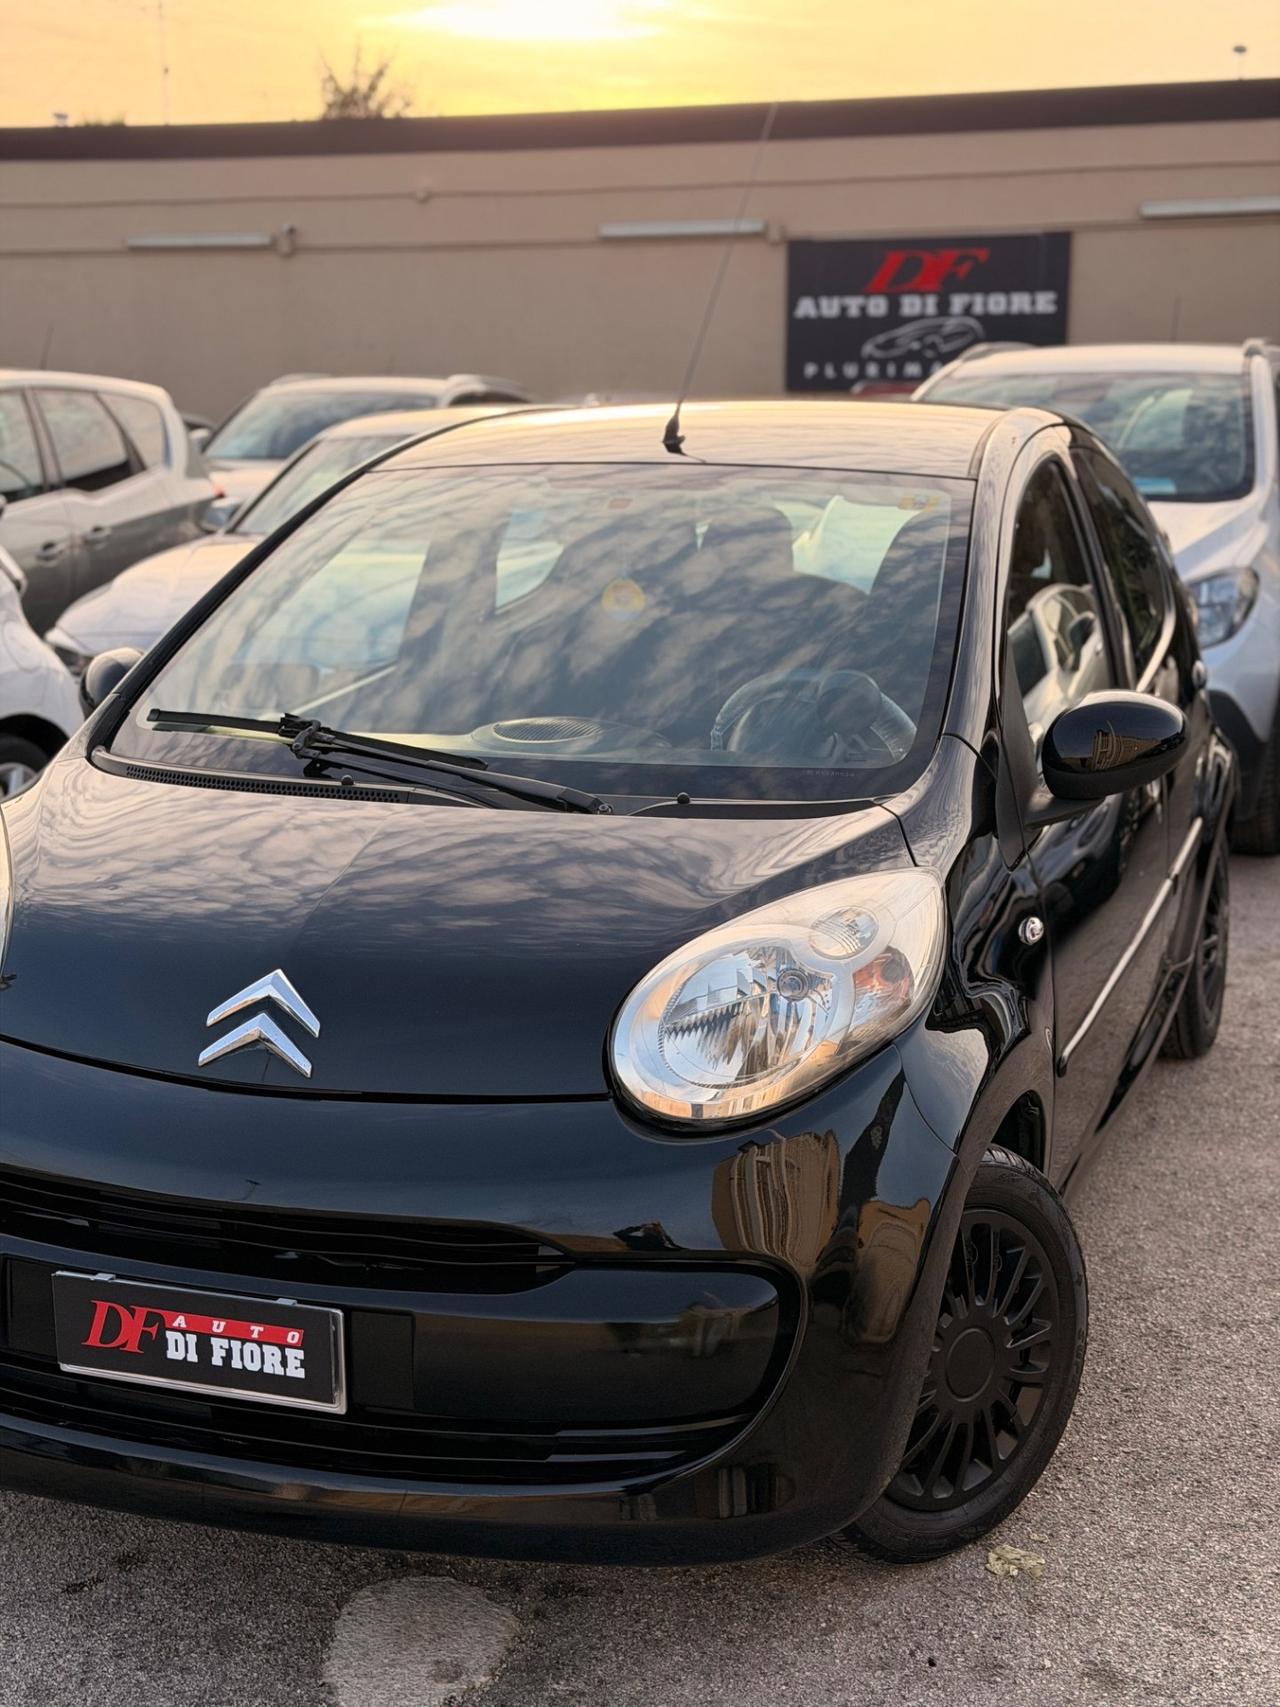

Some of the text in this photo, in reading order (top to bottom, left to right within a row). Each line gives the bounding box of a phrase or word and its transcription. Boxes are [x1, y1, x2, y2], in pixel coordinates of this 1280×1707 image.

[863, 247, 991, 293] DF
[794, 291, 1058, 319] AUTO DI FIORE
[81, 1300, 160, 1354] DF
[172, 1315, 300, 1344] AUTO
[165, 1330, 306, 1379] DI FIORE
